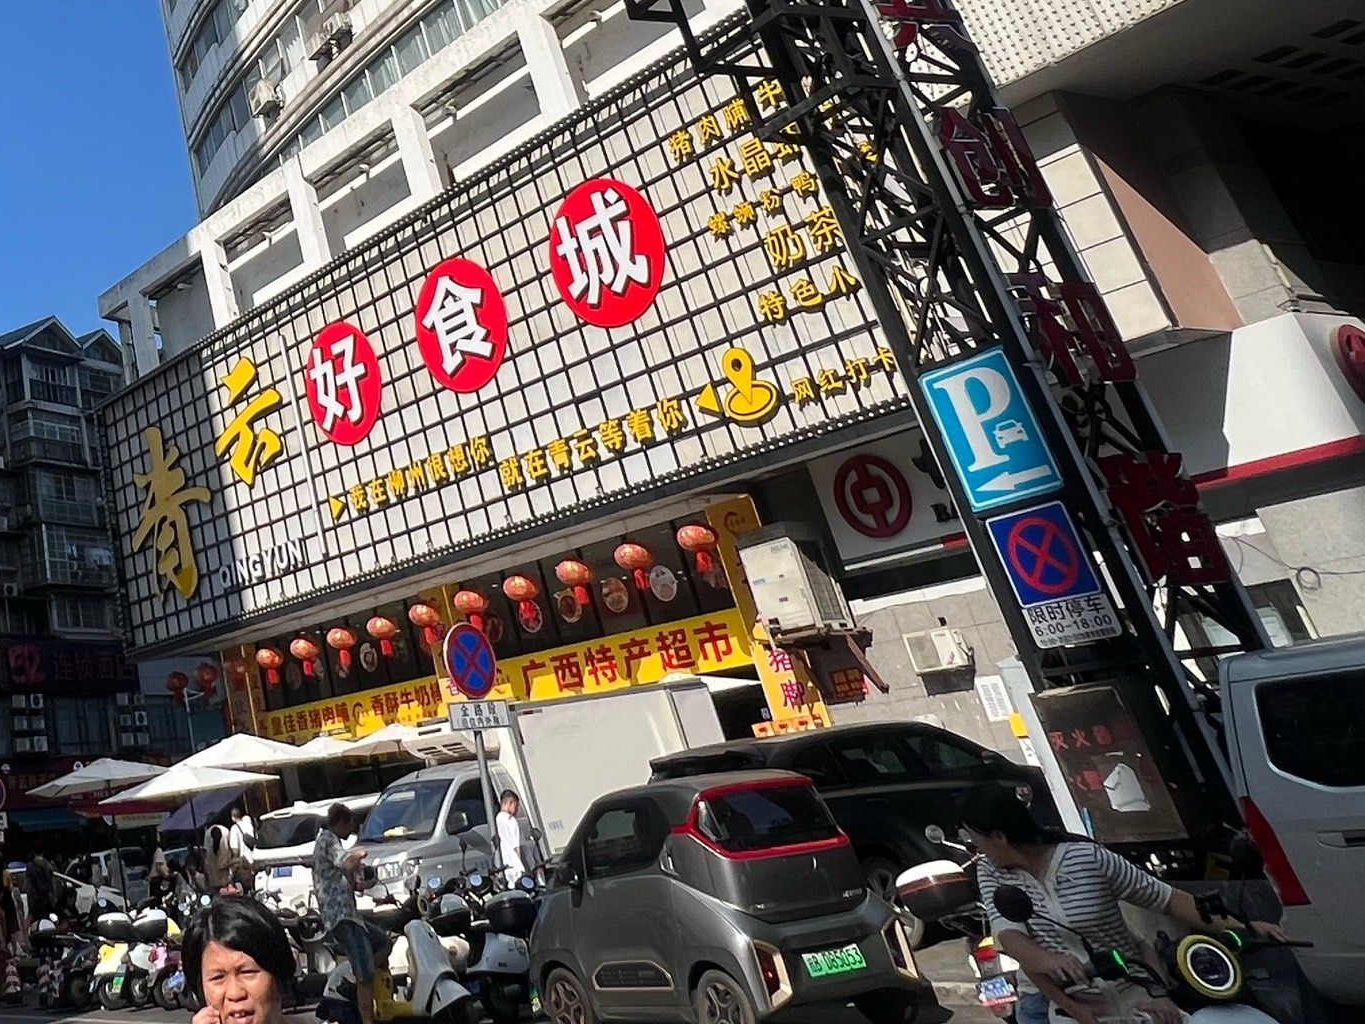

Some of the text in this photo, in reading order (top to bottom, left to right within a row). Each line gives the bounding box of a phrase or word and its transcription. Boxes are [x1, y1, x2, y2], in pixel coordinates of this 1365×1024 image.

[764, 205, 843, 268] 奶茶
[131, 188, 652, 601] 青云 好食城
[348, 398, 687, 512] 我在柳州很想你 就在青云等着你
[219, 538, 305, 588] QINGYUN
[1026, 596, 1106, 626] 限时停车
[1035, 614, 1113, 636] 6:00-18:00
[520, 621, 733, 693] 广西特产超市
